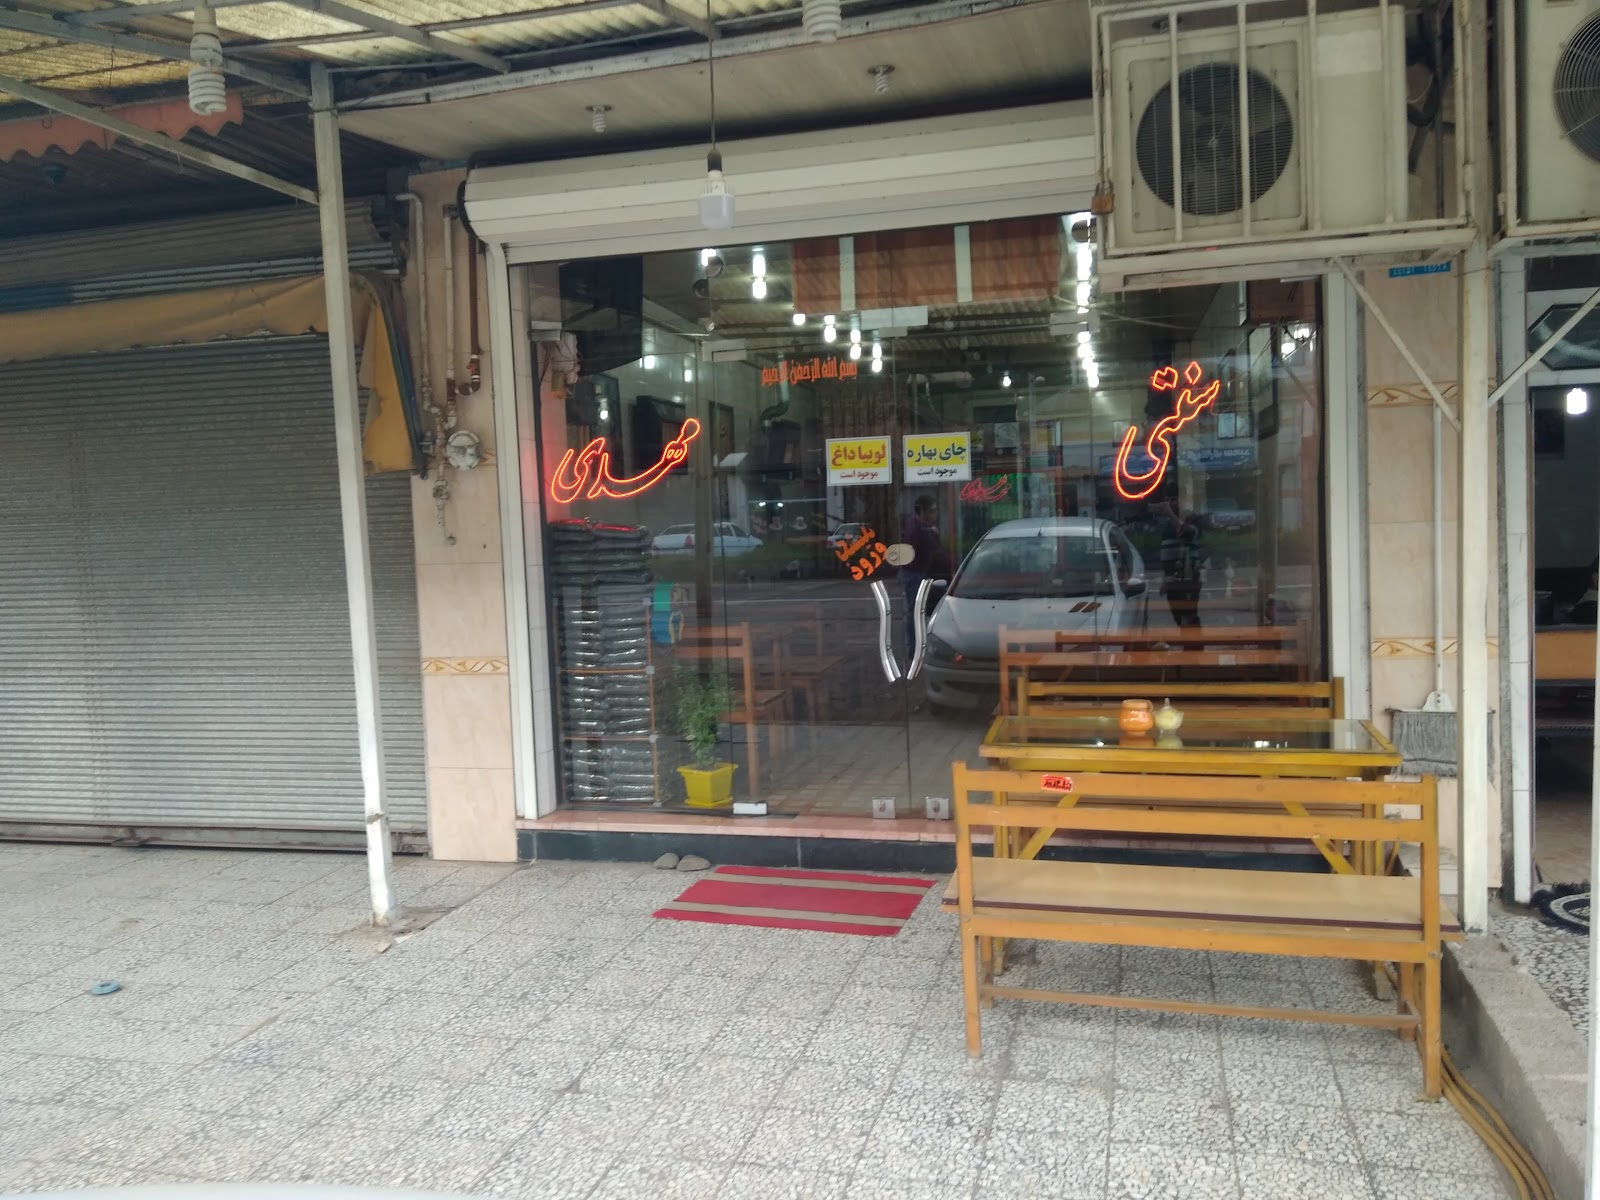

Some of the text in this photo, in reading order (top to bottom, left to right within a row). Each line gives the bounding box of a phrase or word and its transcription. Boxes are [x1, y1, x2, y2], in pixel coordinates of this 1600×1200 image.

[1115, 361, 1220, 499] سنتی
[831, 444, 887, 466] لوبیا داغ
[907, 442, 967, 463] چای بهاره
[840, 470, 879, 480] موجود است
[917, 467, 957, 478] موجود است
